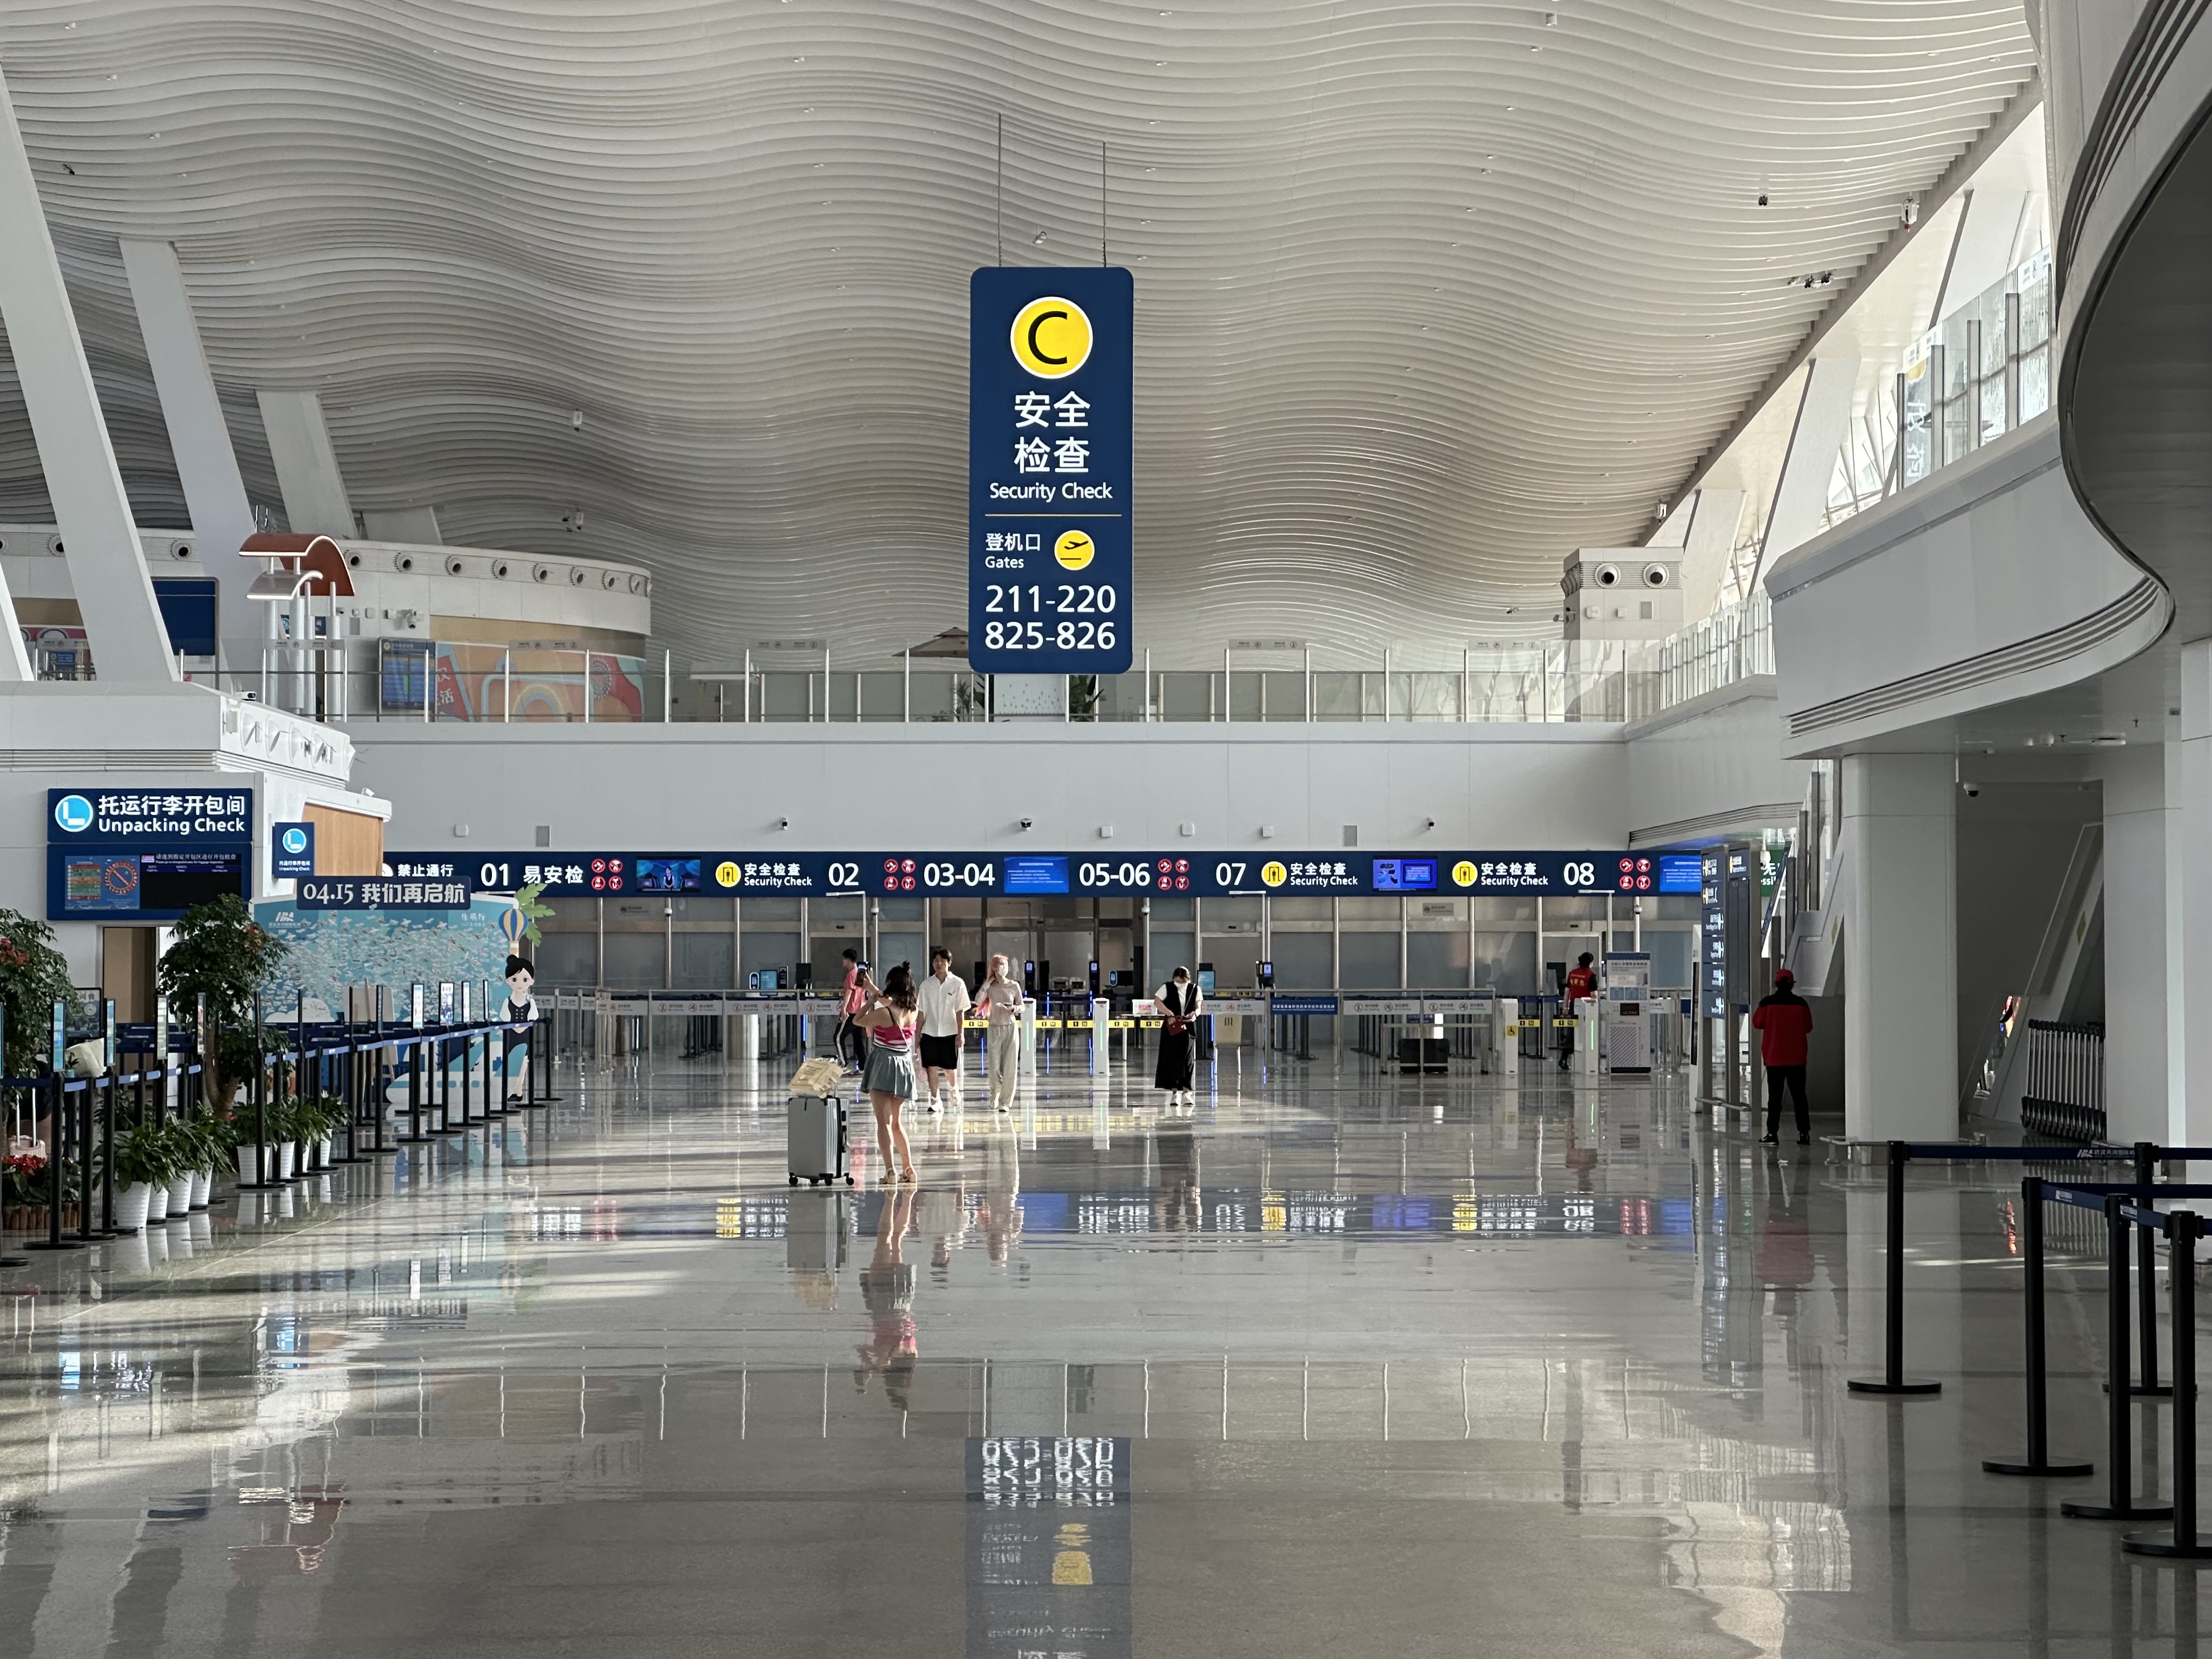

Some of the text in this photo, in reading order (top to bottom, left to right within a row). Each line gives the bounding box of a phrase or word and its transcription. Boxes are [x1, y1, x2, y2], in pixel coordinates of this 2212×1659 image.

[1028, 311, 1068, 365] C
[1014, 390, 1091, 428] 安全
[1014, 436, 1090, 474] 检查
[990, 481, 1113, 503] Security Check
[985, 532, 1040, 551] 登机口
[985, 556, 1024, 568] Gates
[986, 585, 1116, 613] 211-220
[985, 621, 1115, 649] 825-826
[98, 795, 245, 816] 托运行李开包间
[99, 817, 245, 835] Unpacking Check
[398, 864, 454, 877] 禁止通行
[481, 863, 508, 886] 01
[523, 865, 583, 884] 易安检
[744, 862, 800, 876] 安全检查
[828, 863, 859, 886] 02
[924, 863, 995, 886] 03-04
[1079, 863, 1151, 886] 05-06
[1216, 863, 1247, 886] 07
[1290, 862, 1346, 876] 安全检查
[1481, 862, 1537, 876] 安全检查
[1563, 862, 1595, 886] 08
[744, 876, 812, 888] Security Check
[1290, 876, 1358, 888] Security Check
[1481, 876, 1549, 888] Security Check
[303, 883, 465, 905] 04.15 我们再启航
